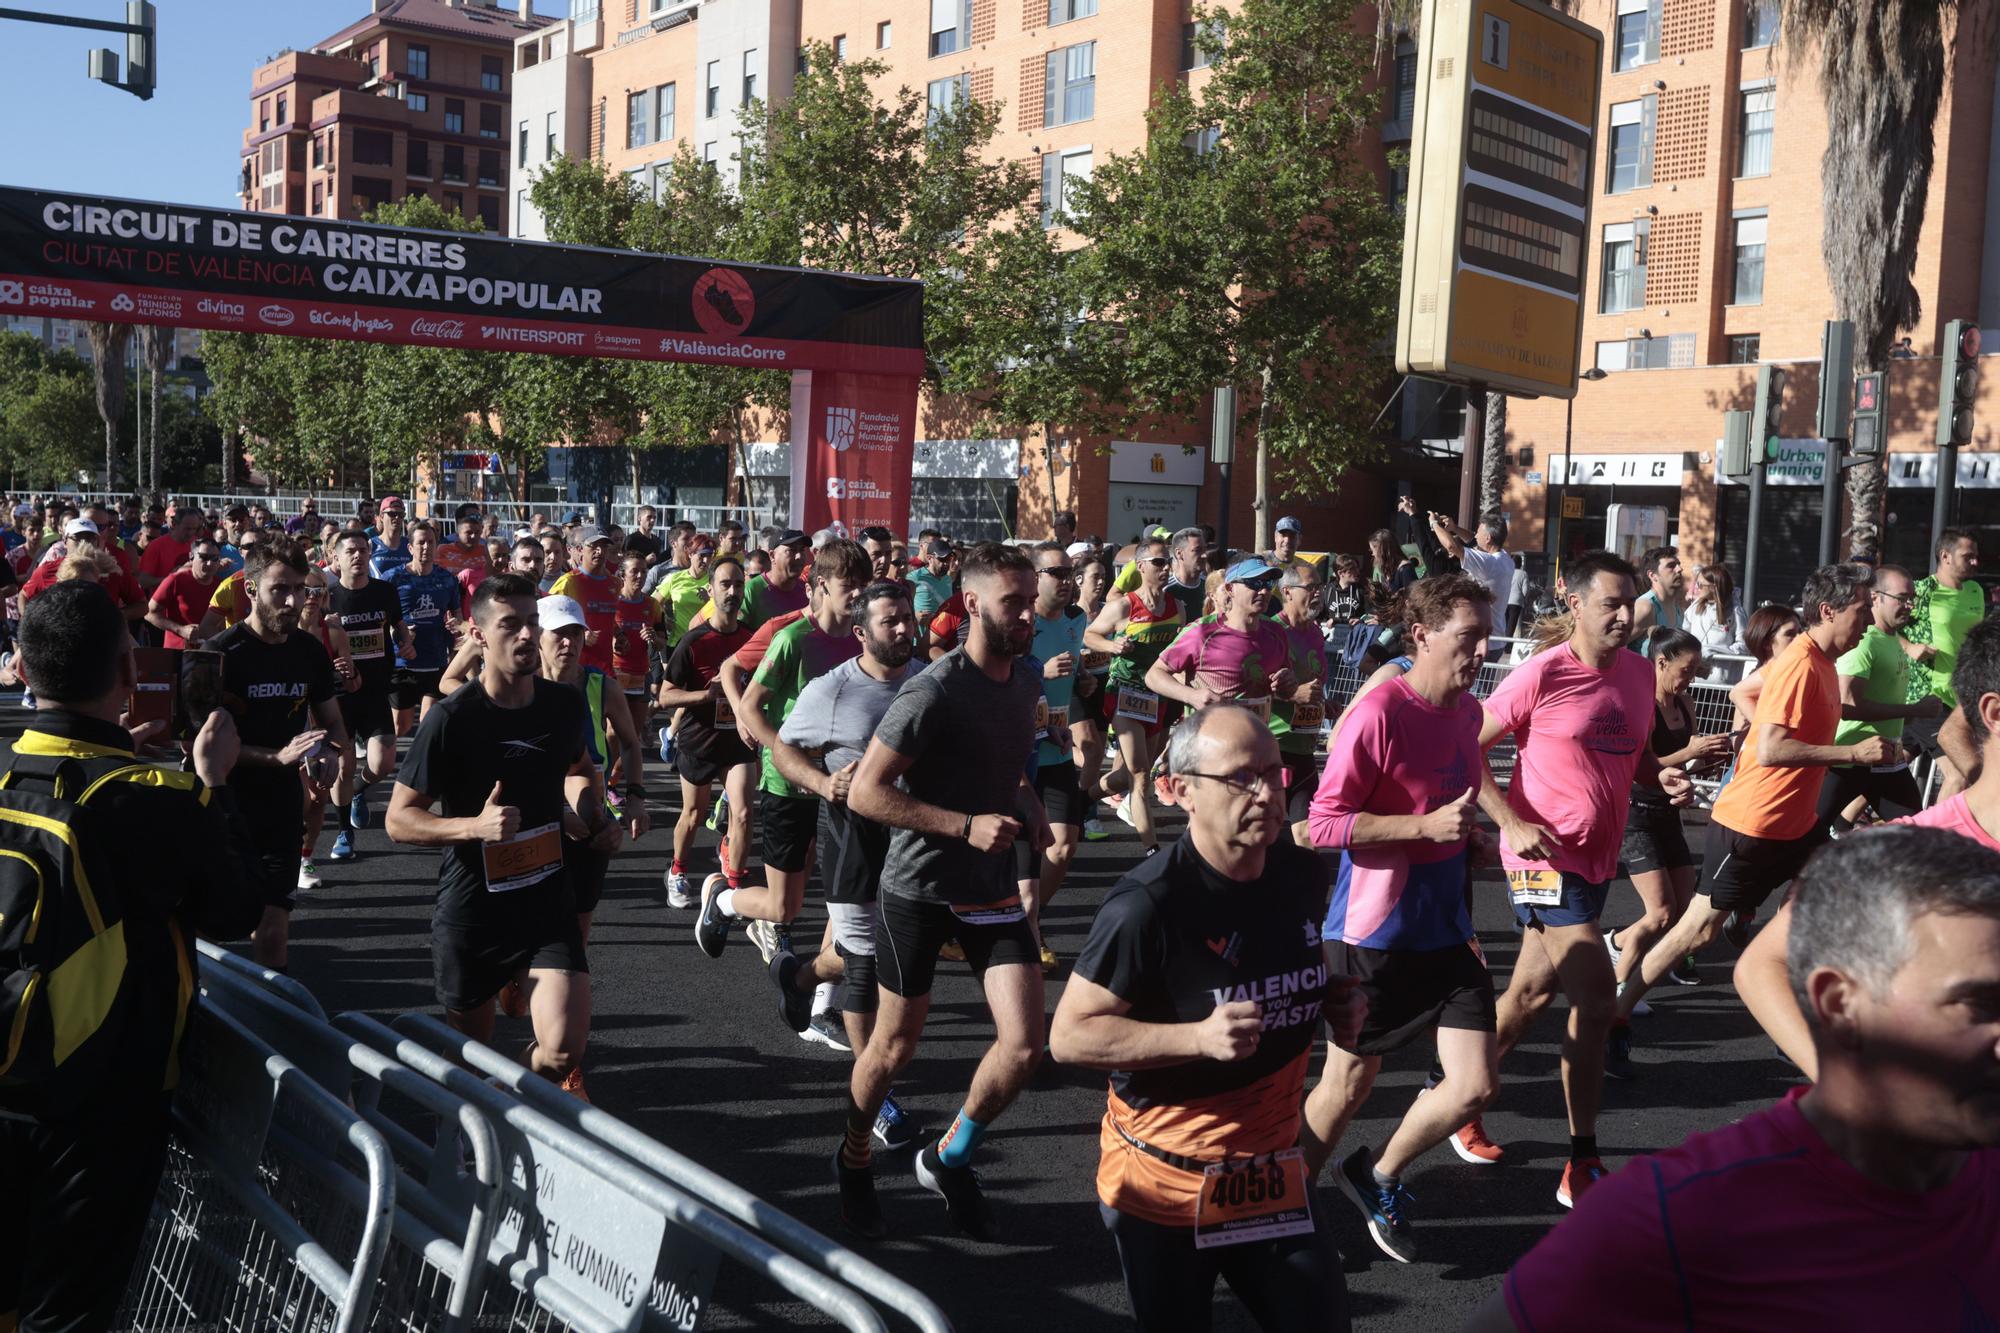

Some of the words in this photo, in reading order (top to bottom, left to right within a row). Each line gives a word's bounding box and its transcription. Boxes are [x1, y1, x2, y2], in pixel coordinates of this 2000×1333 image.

[43, 201, 201, 244] CIRCUIT
[213, 219, 262, 250] DE
[270, 225, 466, 271] CARRERES
[43, 240, 138, 271] CIUTAT
[146, 250, 181, 275] DE
[188, 253, 315, 287] VALÈNCIA
[28, 284, 72, 296] caixa
[28, 293, 96, 310] popular
[137, 299, 182, 311] TRINIDAD
[197, 298, 244, 316] divina
[137, 308, 182, 319] ALFONSO
[309, 309, 322, 324] El
[322, 311, 352, 328] Corte
[352, 311, 394, 333] Inglés
[410, 317, 465, 340] Coca-Cola
[496, 327, 585, 346] INTERSPORT
[605, 335, 641, 346] aspaym
[659, 338, 786, 361] #ValènciaCorre
[859, 412, 900, 423] Fundació
[858, 422, 900, 433] Esportiva
[858, 431, 900, 443] Municipal
[1780, 448, 1825, 462] Urban
[1767, 463, 1825, 480] unning
[848, 479, 876, 490] caixa
[848, 488, 892, 500] popular
[341, 611, 386, 625] REDOLAT
[248, 683, 307, 698] REDOLAT
[1125, 695, 1149, 710] 4271
[1596, 724, 1628, 736] velas
[1267, 998, 1291, 1011] YOU
[1210, 1166, 1286, 1208] 4058
[564, 1232, 637, 1308] RUNNING
